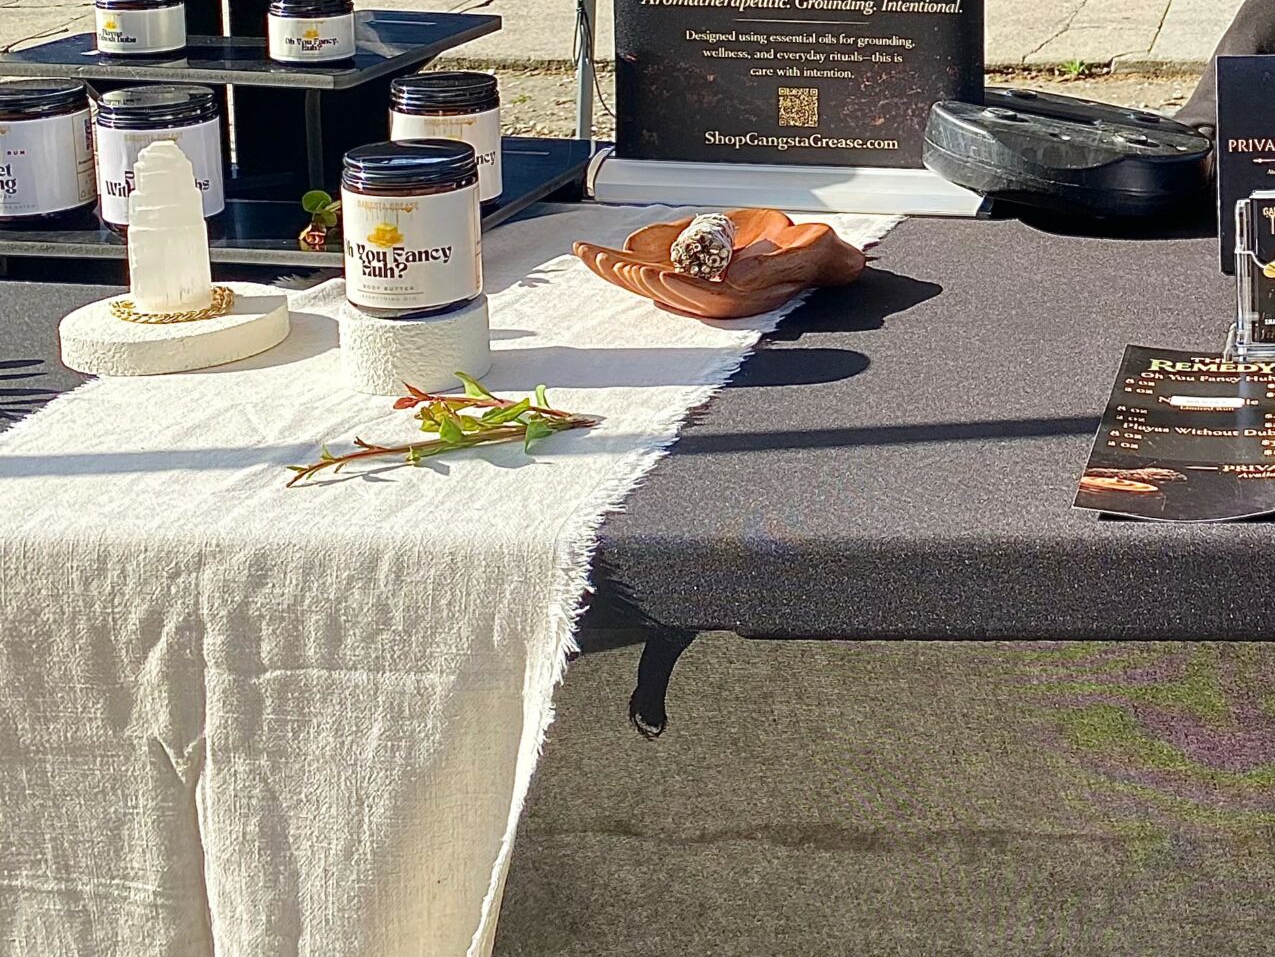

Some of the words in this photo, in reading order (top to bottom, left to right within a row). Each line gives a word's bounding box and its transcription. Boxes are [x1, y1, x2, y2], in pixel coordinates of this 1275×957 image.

[685, 29, 736, 42] Designed
[739, 31, 768, 44] using
[770, 32, 816, 44] essential
[818, 32, 837, 44] oils
[839, 33, 855, 45] for
[702, 47, 751, 60] wellness,
[754, 48, 774, 59] and
[777, 49, 826, 63] everyday
[894, 53, 903, 63] is
[750, 68, 774, 77] care
[777, 66, 800, 78] with
[803, 67, 855, 79] intention.
[704, 130, 899, 151] ShopGangstaGrease.com
[475, 150, 496, 165] ncy
[356, 243, 387, 266] You
[392, 245, 452, 264] Fancy
[361, 261, 408, 279] Huh?
[1140, 371, 1163, 380] Oh
